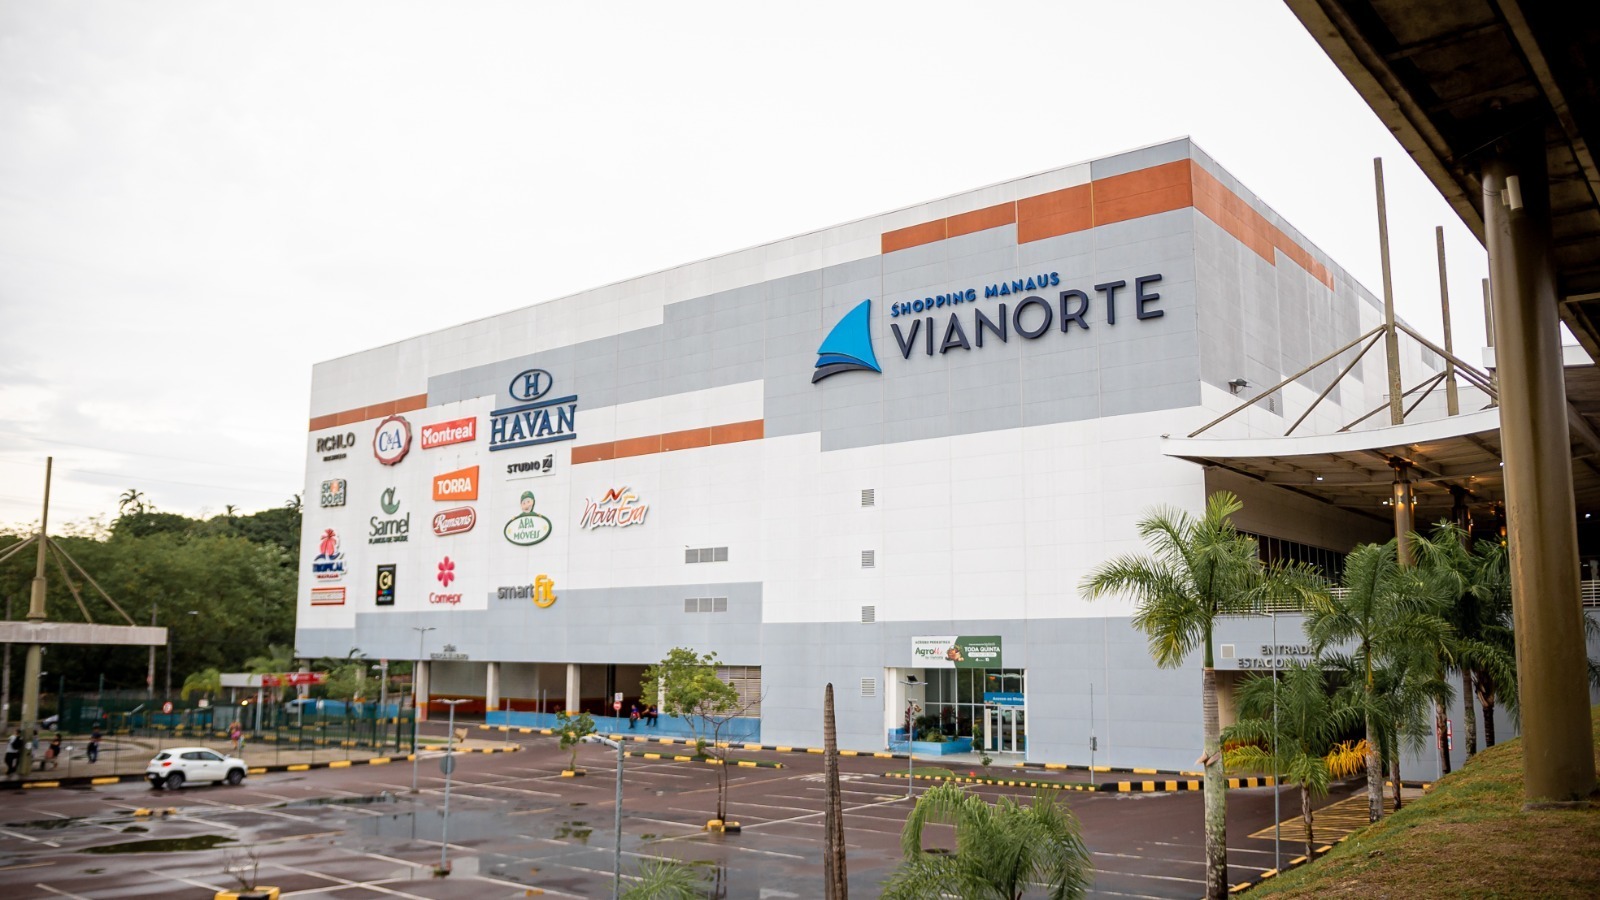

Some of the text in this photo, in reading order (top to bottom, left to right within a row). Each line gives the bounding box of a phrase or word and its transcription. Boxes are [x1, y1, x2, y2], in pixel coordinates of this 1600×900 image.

[890, 271, 1061, 318] SHOPPING MANAUS
[890, 273, 1165, 360] VIANORTE
[423, 422, 473, 446] Montreal
[489, 404, 577, 445] HAVAN
[379, 428, 402, 452] C&A
[507, 461, 540, 474] STUDIO
[437, 477, 472, 495] TORRA
[369, 511, 410, 537] Samel
[518, 518, 534, 529] APA
[1261, 644, 1317, 655] ENTRADA
